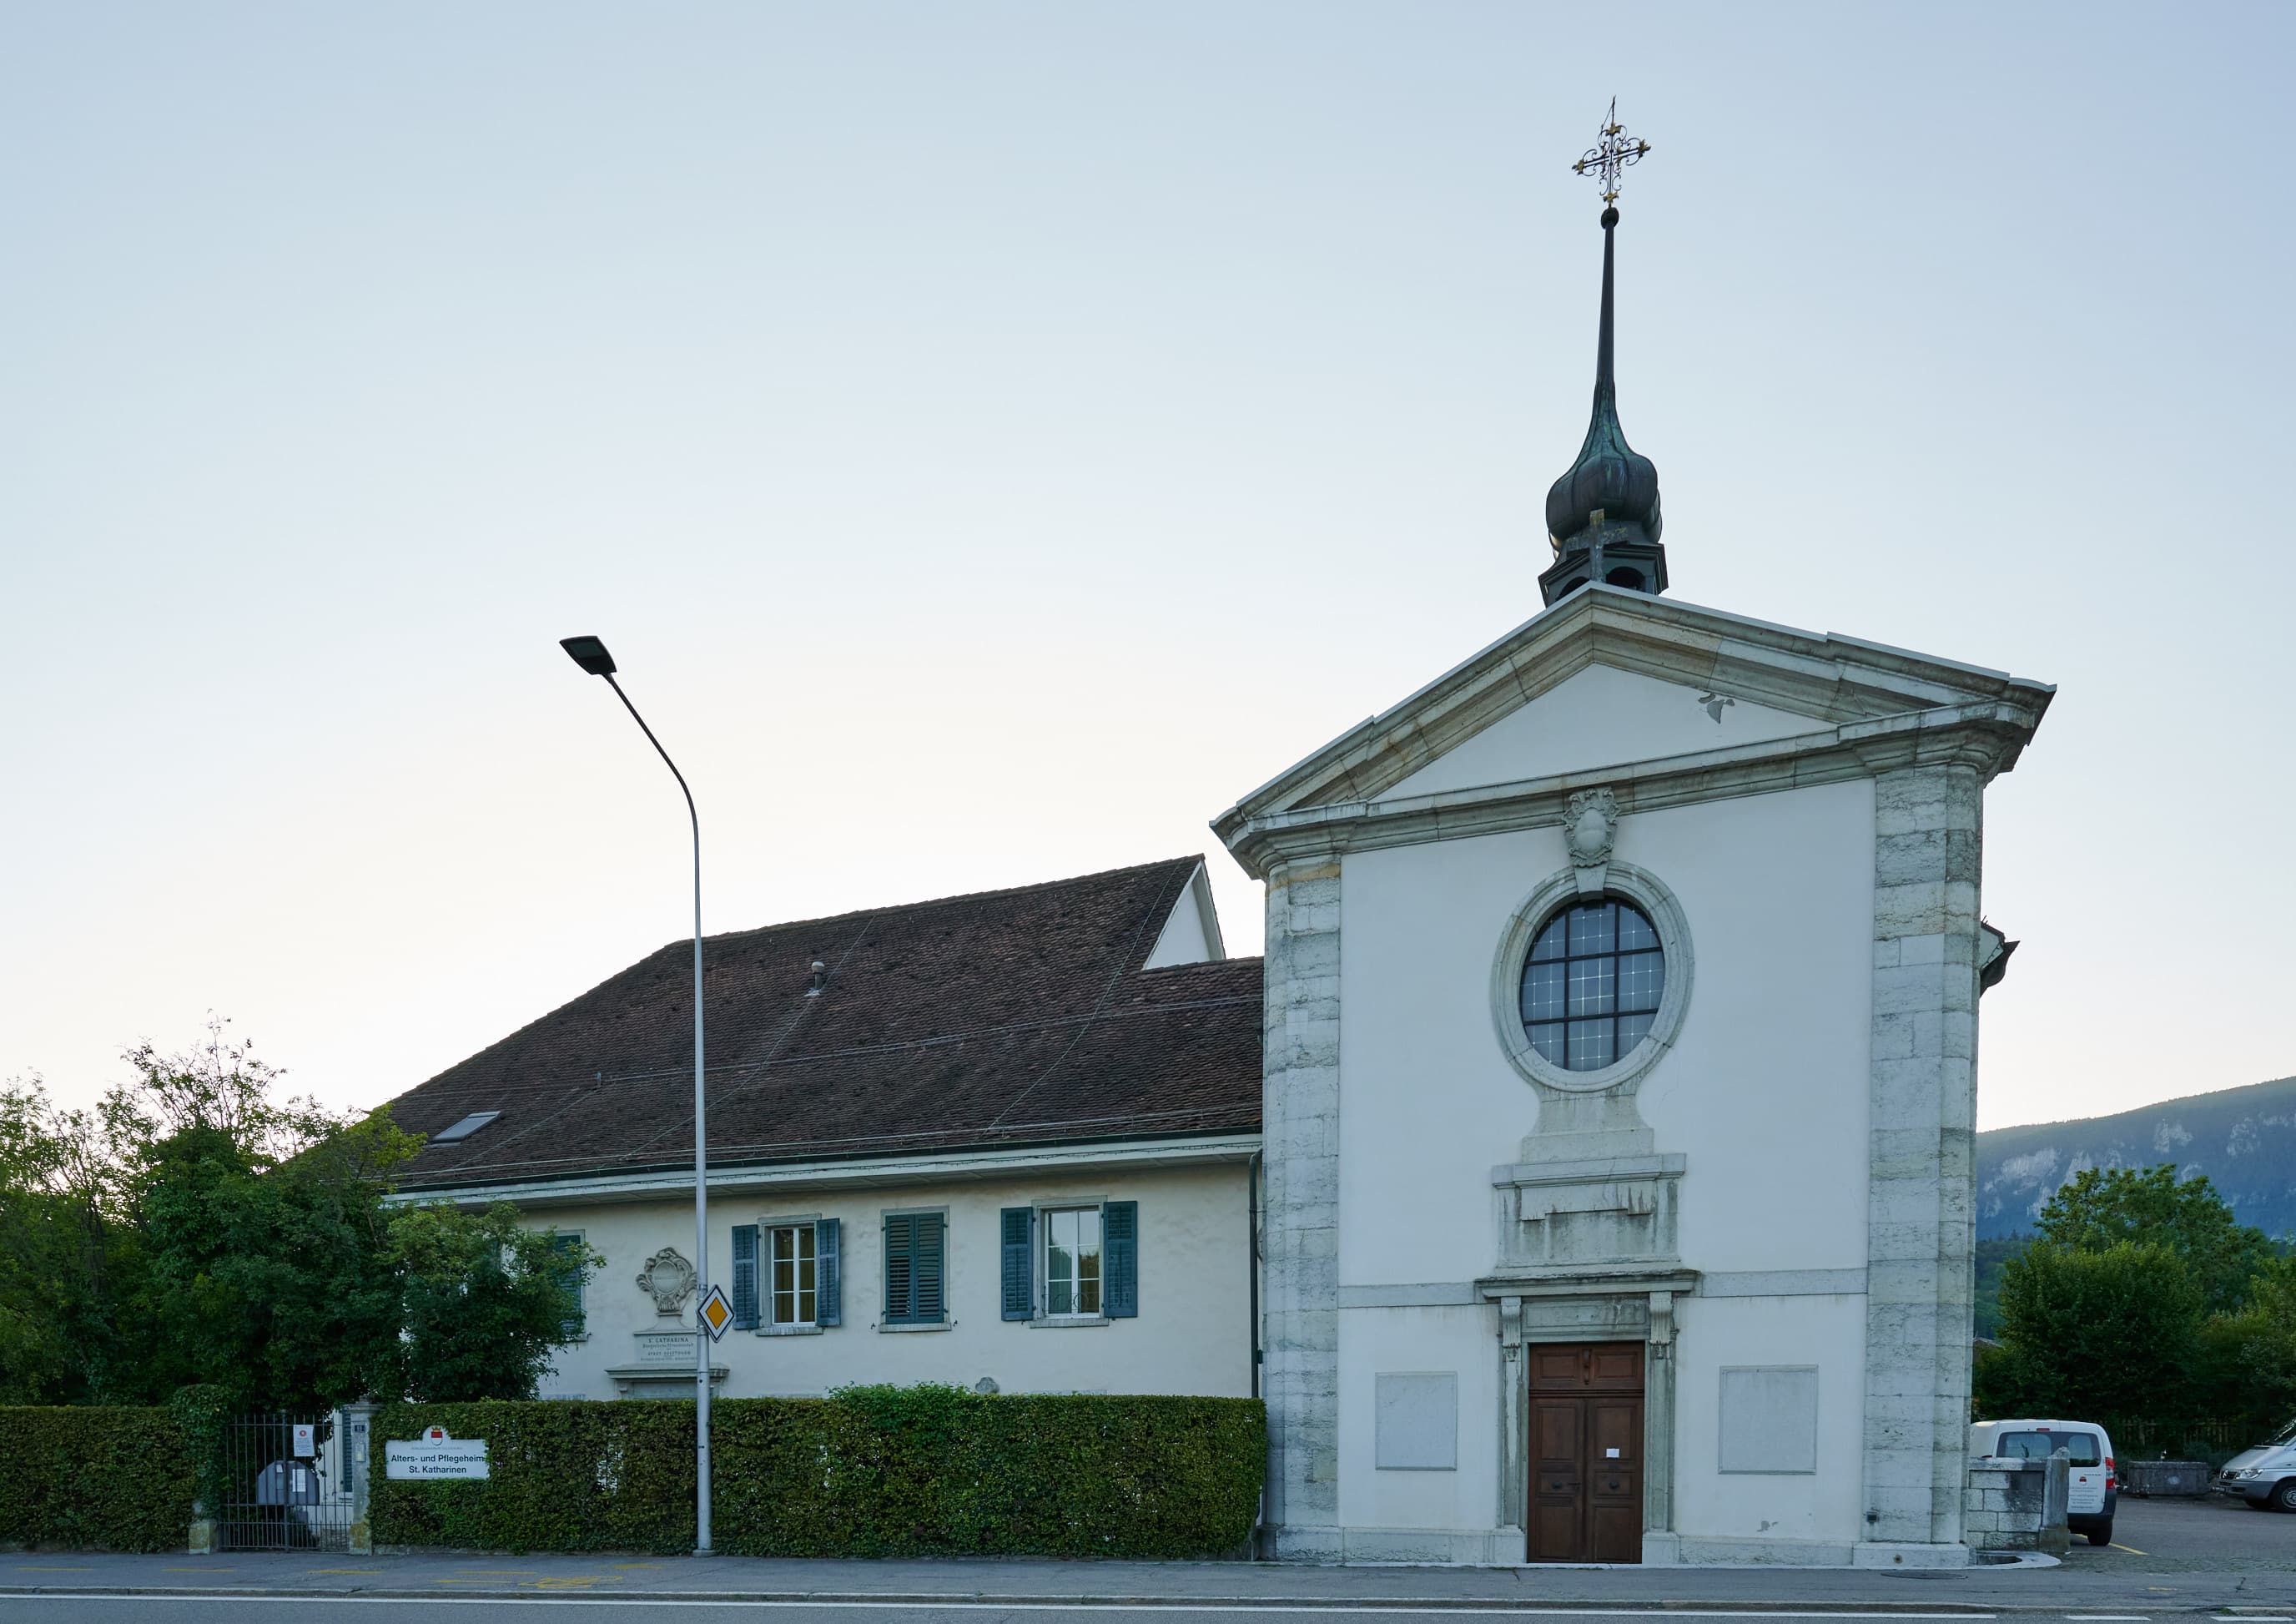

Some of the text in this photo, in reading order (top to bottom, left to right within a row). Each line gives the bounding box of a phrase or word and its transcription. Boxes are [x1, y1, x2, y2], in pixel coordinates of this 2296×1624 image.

[438, 1455, 485, 1464] Pflegeheim
[409, 1465, 466, 1474] St. Katharinen
